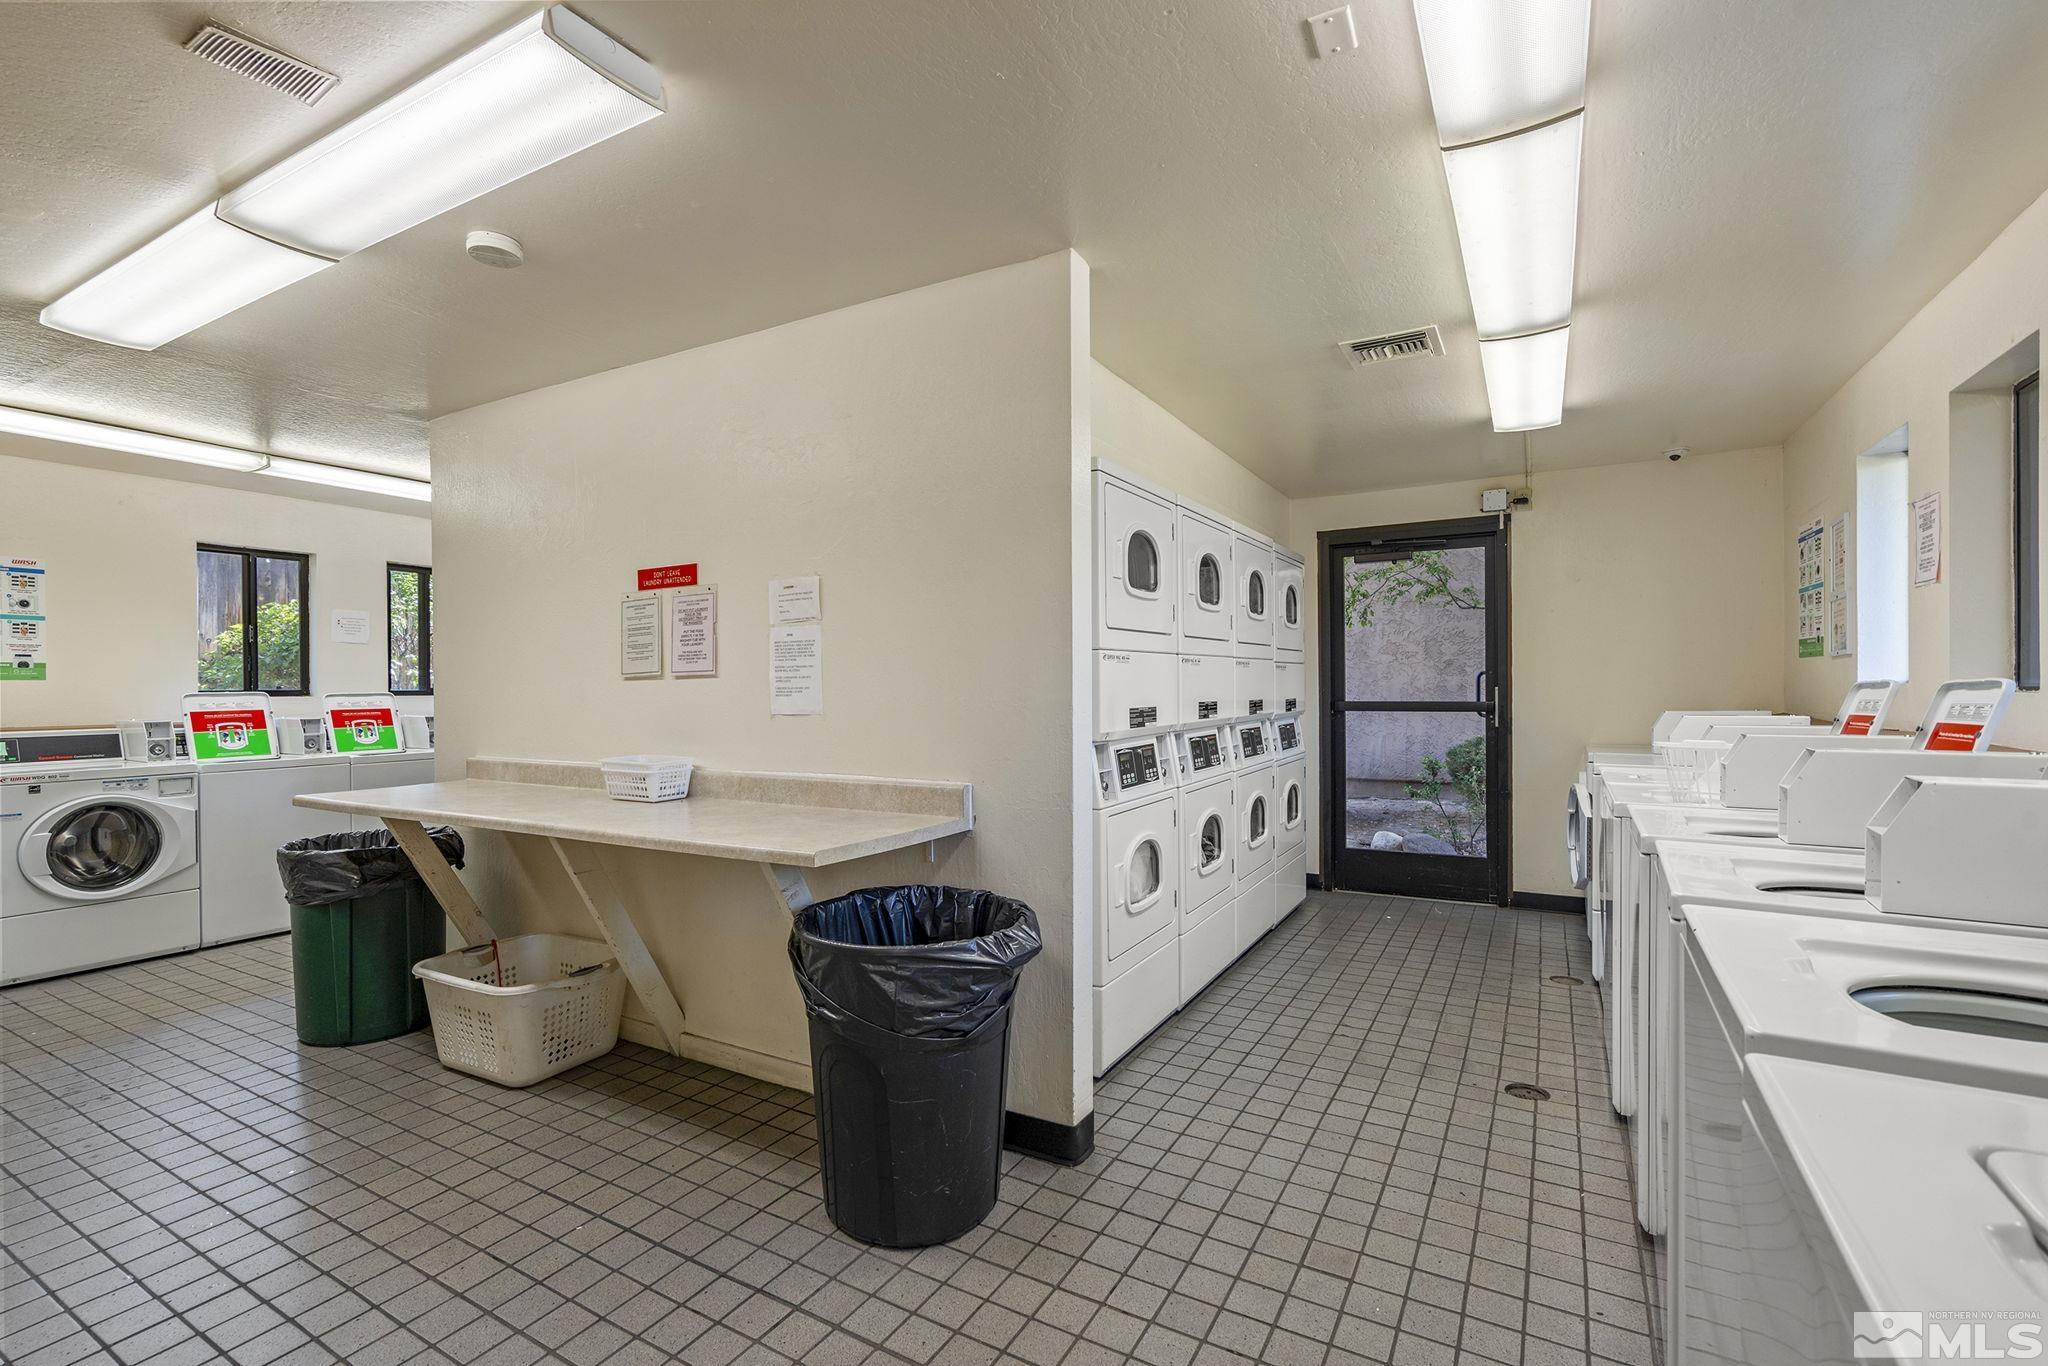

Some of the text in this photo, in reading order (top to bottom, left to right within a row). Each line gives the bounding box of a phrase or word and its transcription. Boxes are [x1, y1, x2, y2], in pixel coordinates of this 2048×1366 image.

[11, 558, 37, 566] WASH
[667, 569, 680, 577] LEAVE
[643, 575, 692, 587] LAUNDRY UNATTENDED
